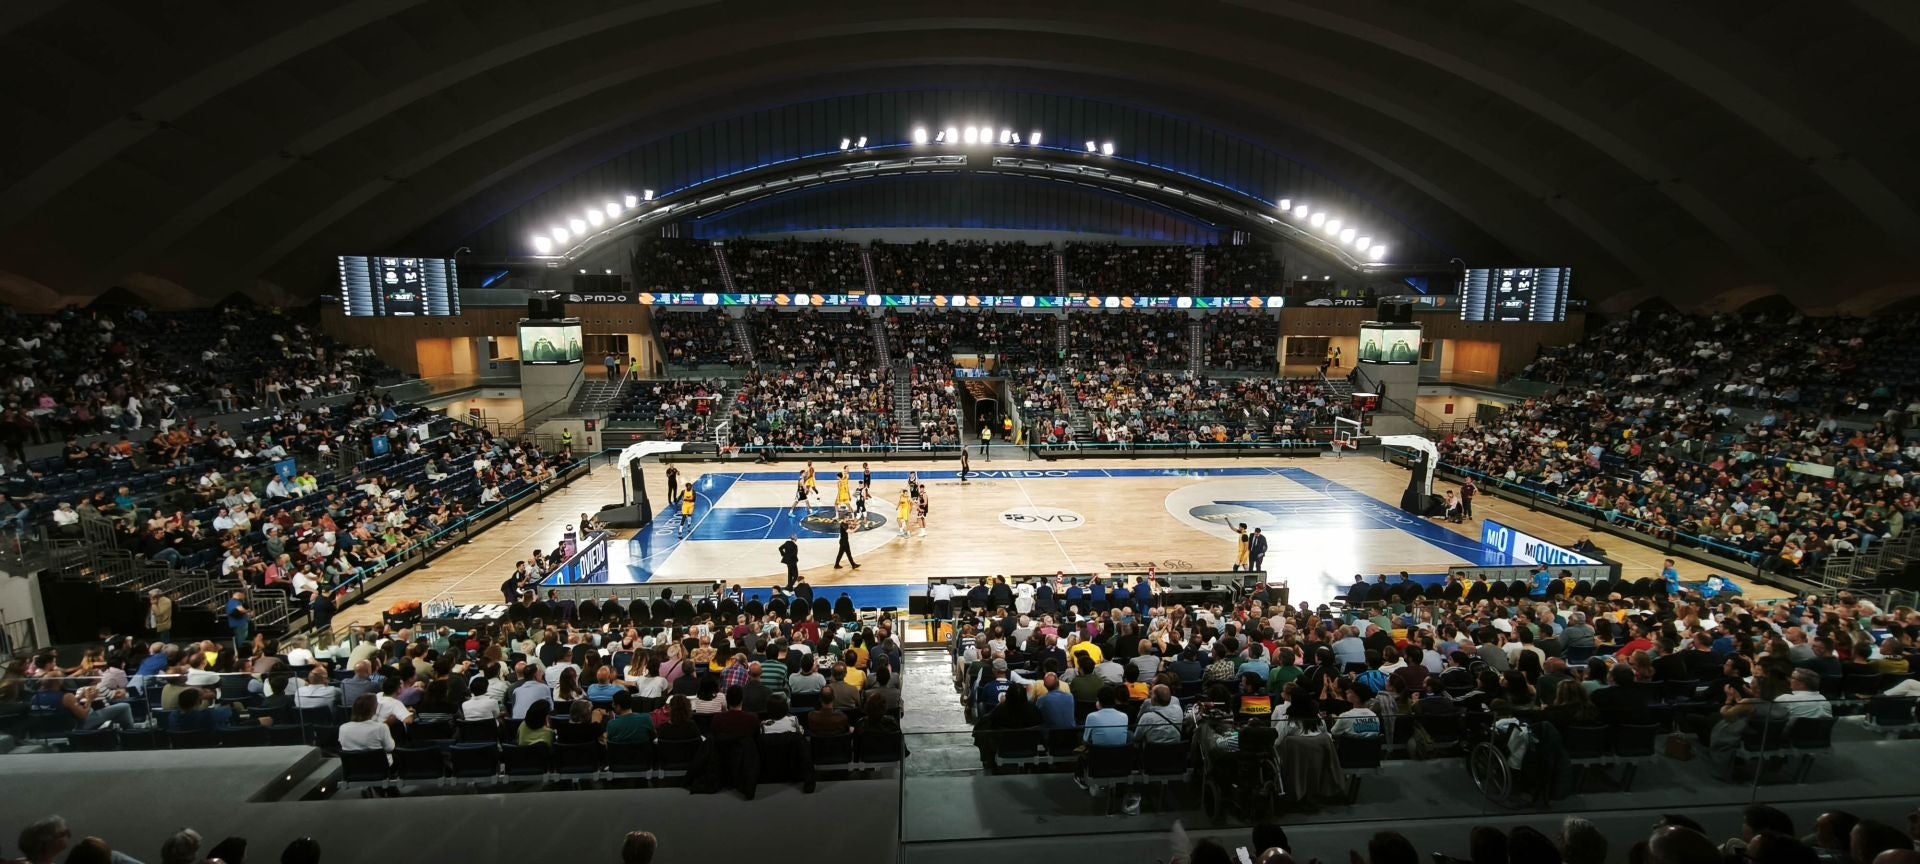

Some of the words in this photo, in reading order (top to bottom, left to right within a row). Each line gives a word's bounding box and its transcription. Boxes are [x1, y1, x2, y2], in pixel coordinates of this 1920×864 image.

[584, 294, 627, 302] PMDO
[956, 470, 1069, 478] OVIEDO
[1013, 513, 1078, 523] OVD
[1486, 527, 1509, 552] MIO
